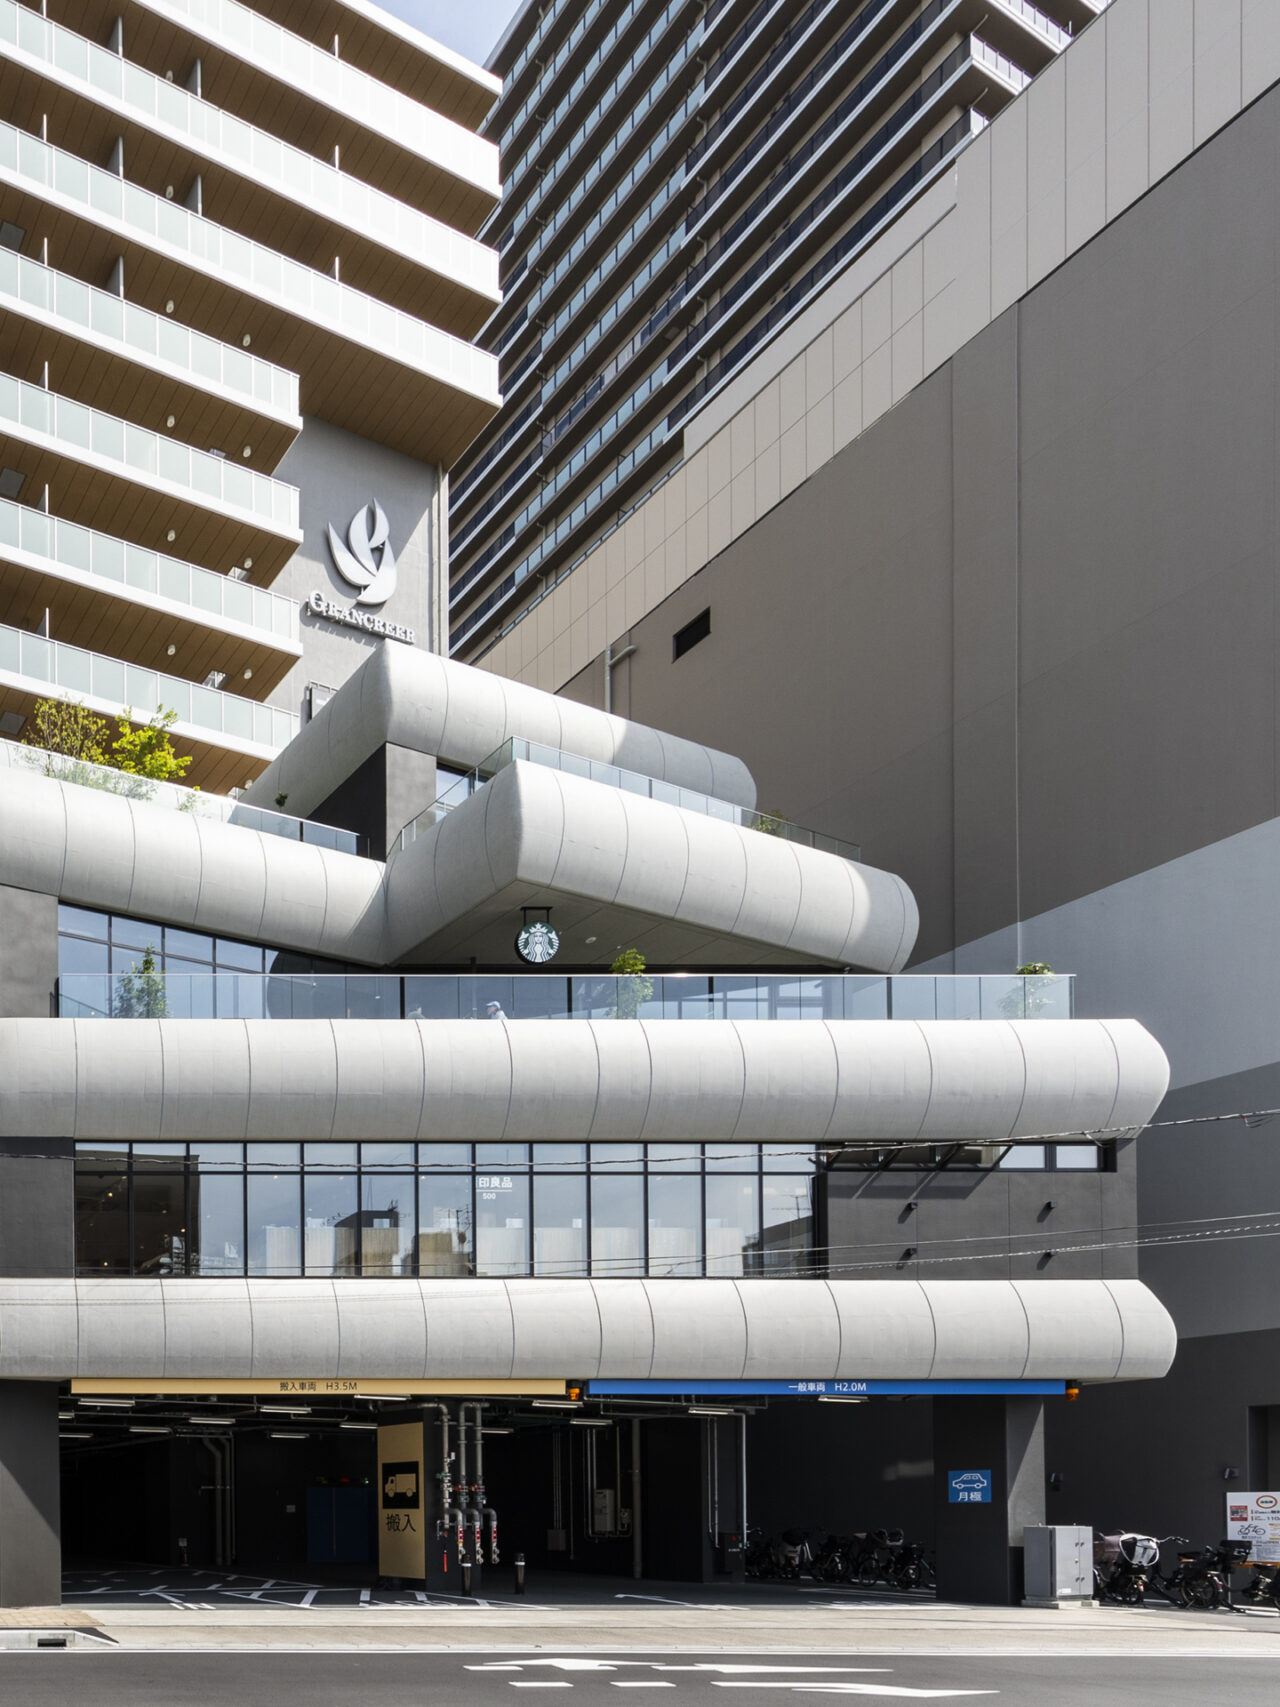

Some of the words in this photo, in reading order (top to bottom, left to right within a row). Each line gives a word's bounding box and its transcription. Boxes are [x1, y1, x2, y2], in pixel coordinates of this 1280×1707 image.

[308, 590, 416, 642] GRANCREER
[482, 1192, 497, 1200] 500
[280, 1382, 317, 1391] 搬入車両
[326, 1382, 358, 1391] H3.5M
[788, 1382, 826, 1392] 一般車両
[834, 1382, 867, 1392] H2.0M
[958, 1491, 982, 1502] 月極
[385, 1513, 417, 1533] 搬入
